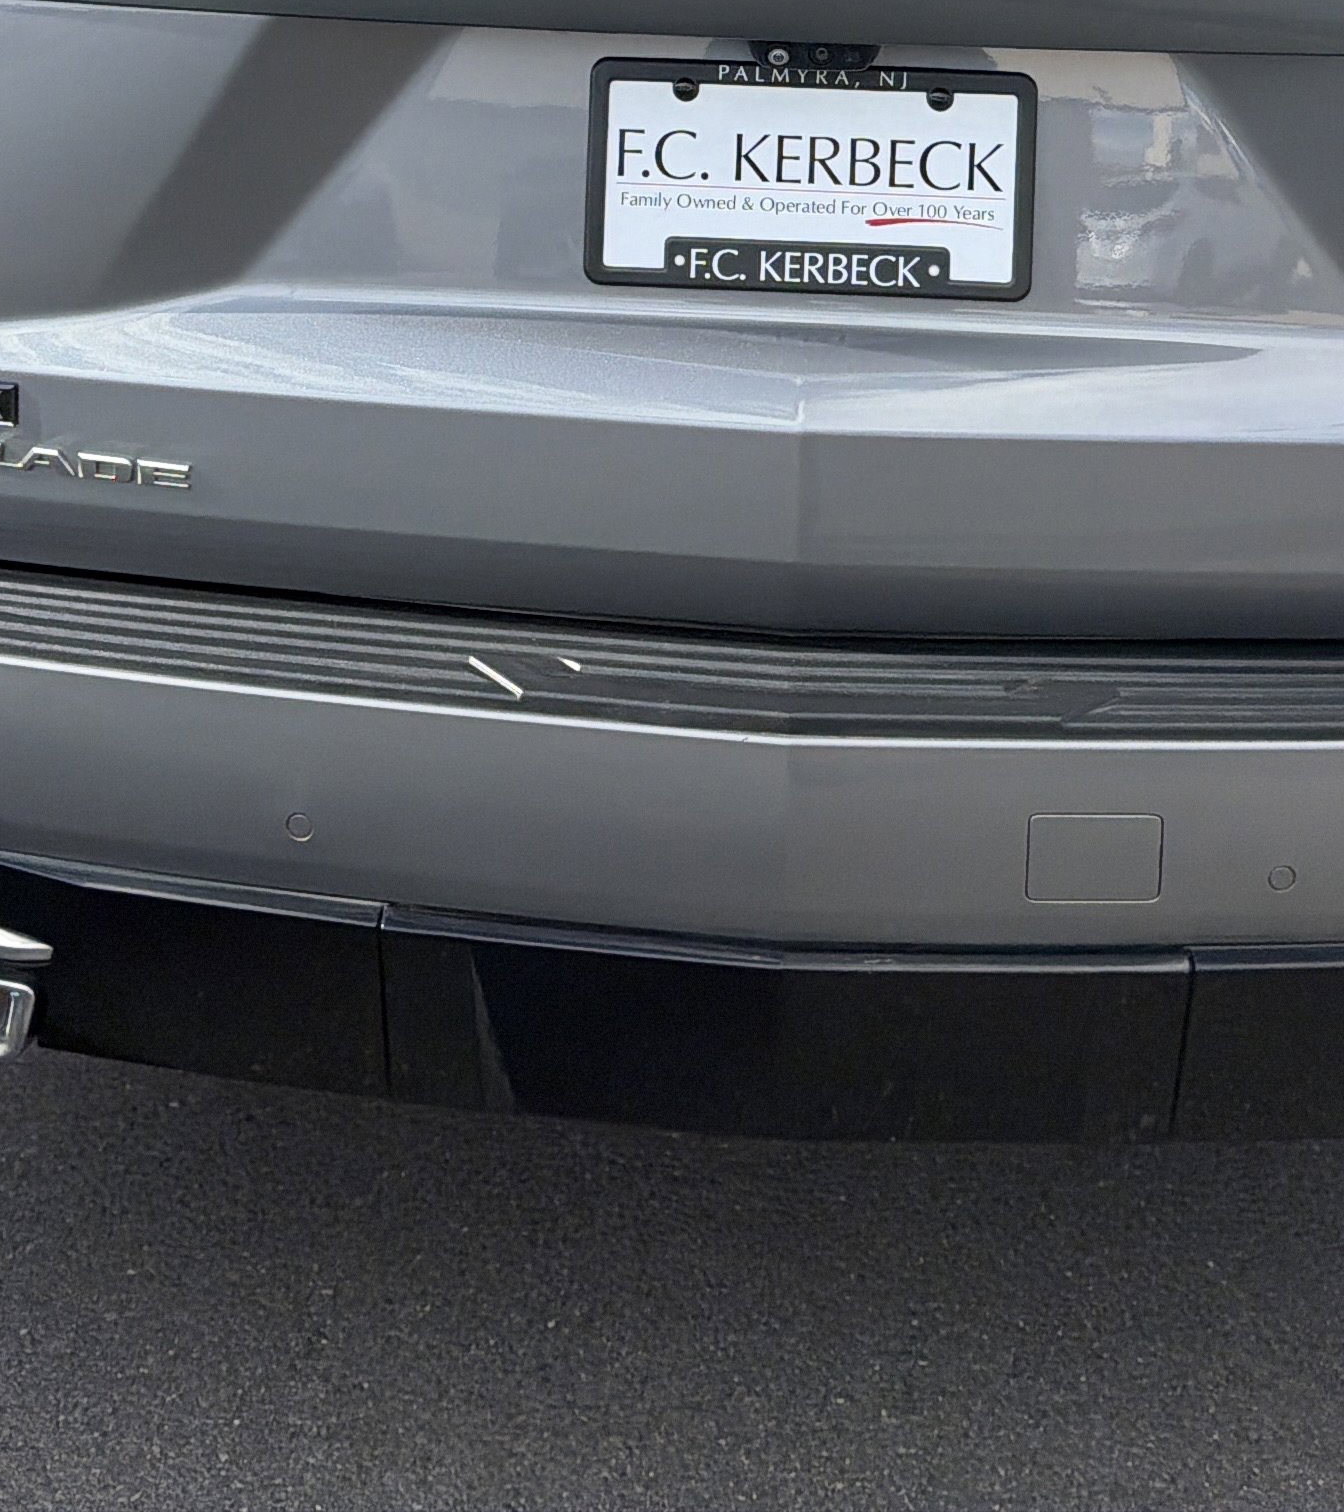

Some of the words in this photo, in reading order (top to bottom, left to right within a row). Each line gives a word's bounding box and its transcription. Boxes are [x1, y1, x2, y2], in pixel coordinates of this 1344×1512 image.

[718, 64, 860, 88] PALMYRA,
[879, 70, 907, 90] NJ
[616, 128, 710, 181] F.C.
[735, 133, 1004, 193] KERBECK
[620, 191, 673, 210] Family
[676, 193, 736, 211] Owned
[741, 197, 754, 211] &
[760, 197, 836, 216] Operated
[841, 200, 867, 216] For
[872, 202, 913, 218] Over
[918, 203, 948, 219] 100
[953, 205, 995, 221] Years
[689, 248, 746, 280] F.C.
[759, 251, 921, 288] KERBECK
